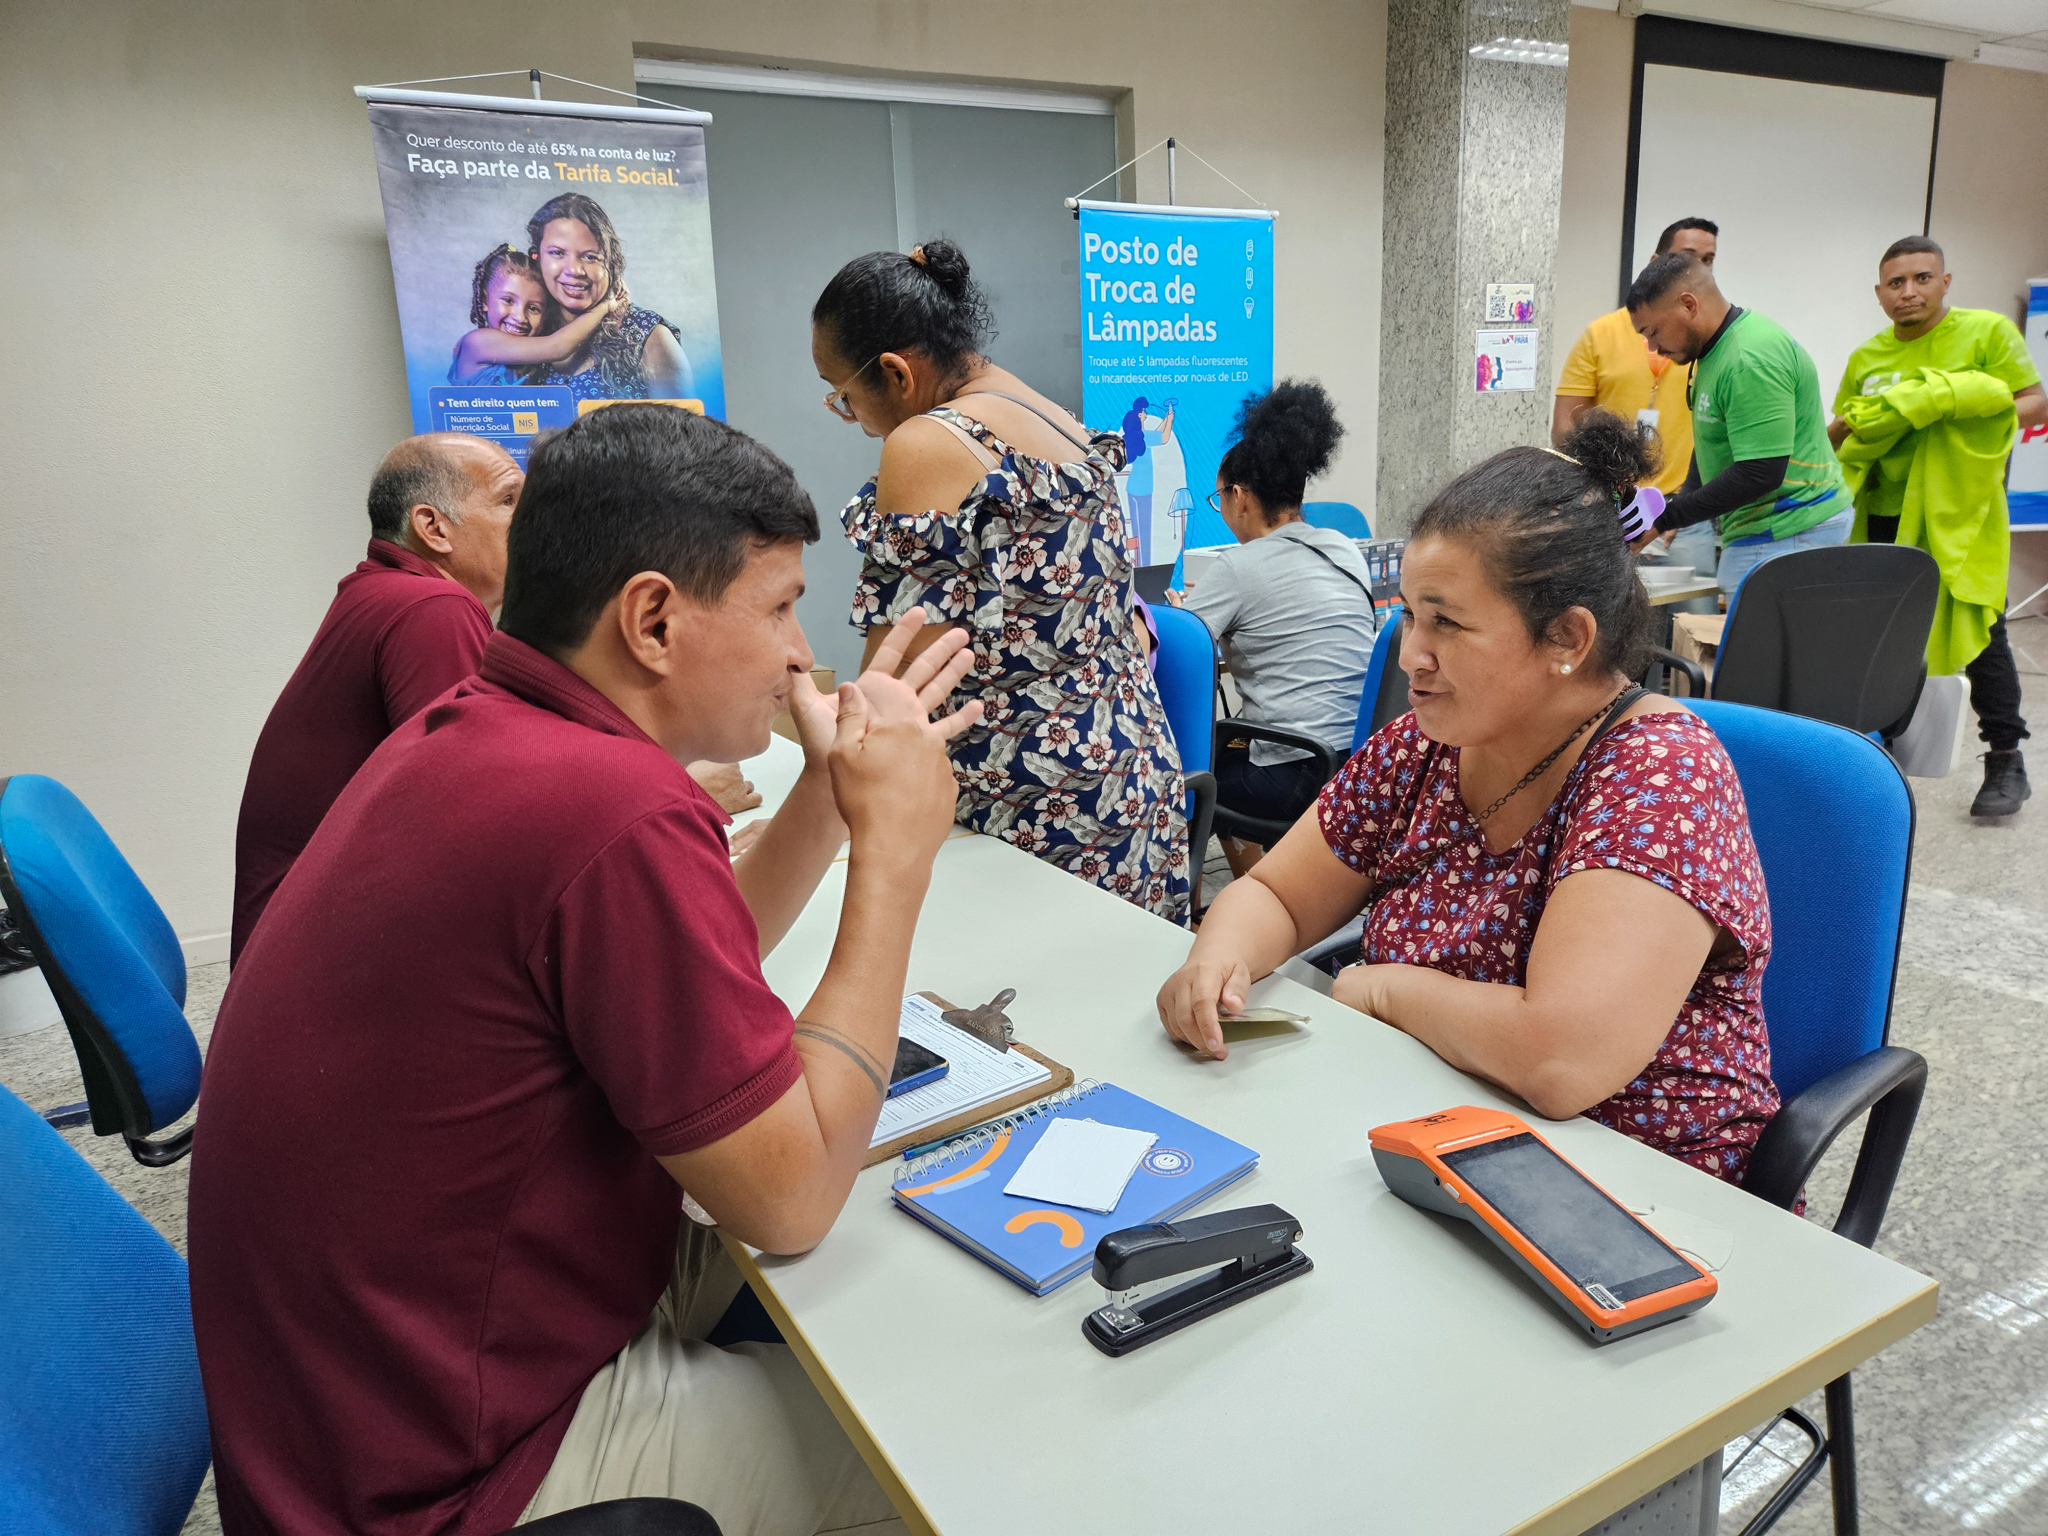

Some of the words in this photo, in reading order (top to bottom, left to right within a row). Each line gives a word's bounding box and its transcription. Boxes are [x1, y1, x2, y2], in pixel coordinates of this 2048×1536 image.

[406, 133, 441, 148] Quer
[443, 135, 505, 152] desconto
[508, 140, 525, 153] de
[527, 142, 549, 155] até
[550, 143, 579, 157] 65%
[580, 147, 597, 158] na
[598, 147, 633, 160] conta
[634, 148, 650, 161] de
[652, 149, 677, 163] luz?
[407, 153, 460, 179] Faça
[463, 159, 520, 180] parte
[524, 160, 552, 180] da
[553, 162, 612, 183] Tarifa
[1084, 232, 1160, 265] Posto
[1166, 235, 1198, 267] de
[1085, 272, 1159, 304] Troca
[1164, 274, 1196, 305] de
[1088, 311, 1218, 348] Lâmpadas
[1088, 355, 1119, 368] Troque
[1121, 356, 1137, 367] até
[1138, 356, 1145, 367] 5
[1147, 355, 1190, 368] lâmpadas
[1191, 354, 1248, 366] fluorescentes
[1088, 374, 1100, 384] ou
[1102, 372, 1172, 384] incandescentes
[1174, 373, 1189, 384] por
[1191, 372, 1217, 383] novas
[1218, 371, 1229, 382] de
[446, 398, 469, 408] Tem
[471, 397, 505, 408] direito
[506, 399, 536, 409] quem
[537, 398, 560, 408] tem:
[450, 415, 481, 423] Número
[482, 415, 493, 423] de
[518, 419, 534, 427] NIS
[451, 424, 486, 433] Inscrição
